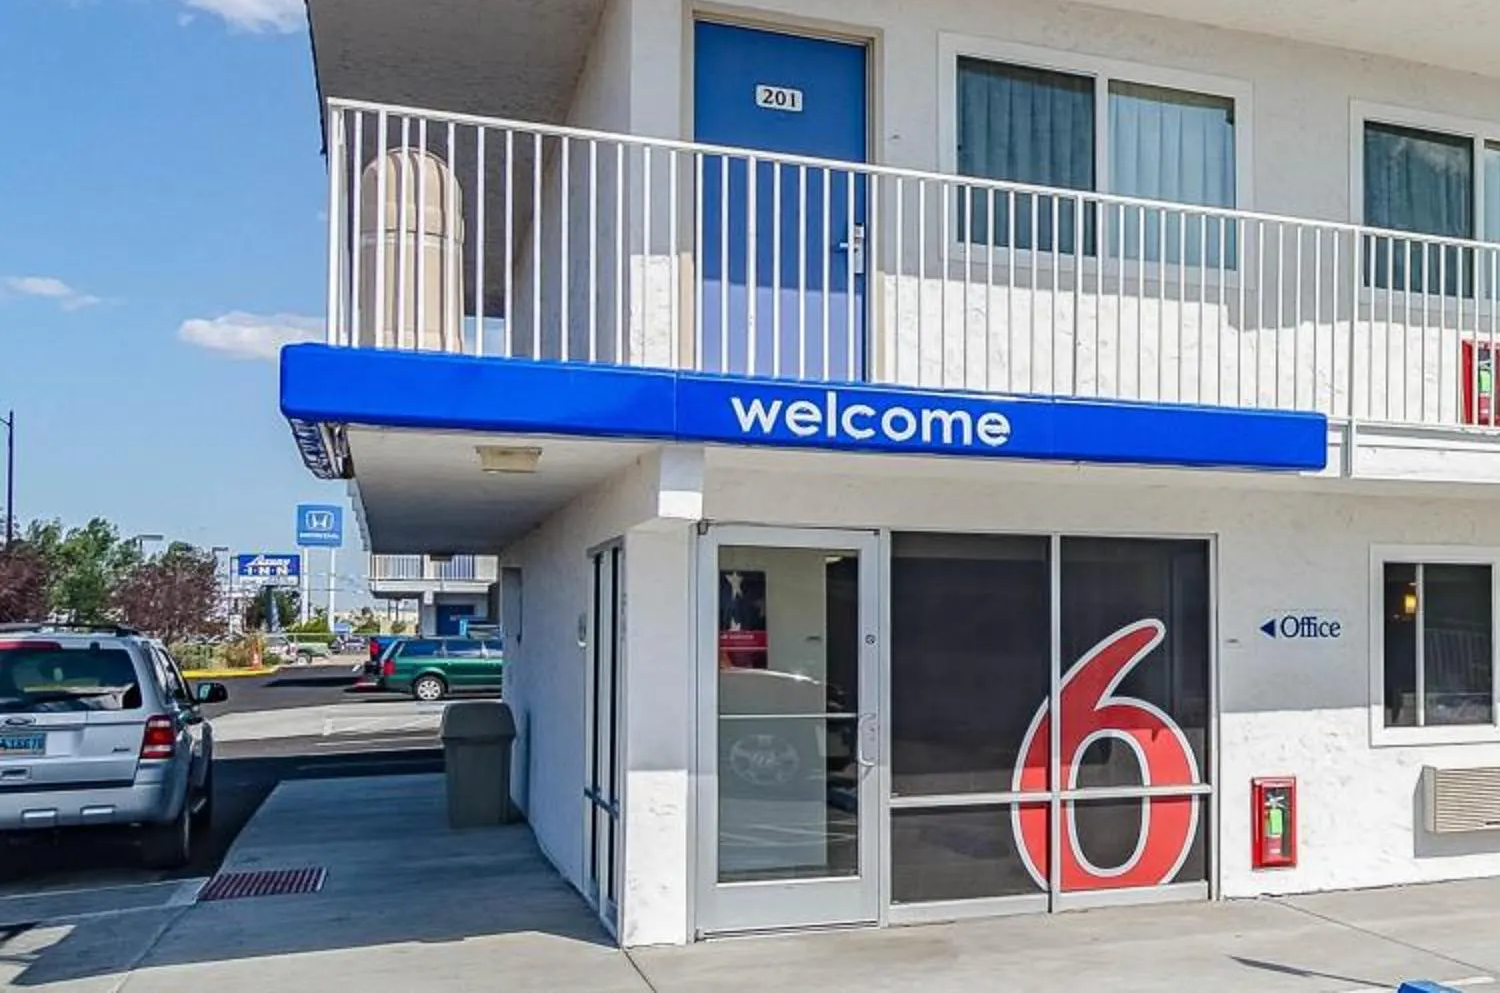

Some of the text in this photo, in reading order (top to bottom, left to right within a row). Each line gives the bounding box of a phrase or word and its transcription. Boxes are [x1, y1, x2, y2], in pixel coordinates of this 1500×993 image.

[762, 88, 796, 108] 201
[731, 391, 1011, 447] welcome
[1280, 614, 1341, 638] Office
[1011, 618, 1200, 892] 6
